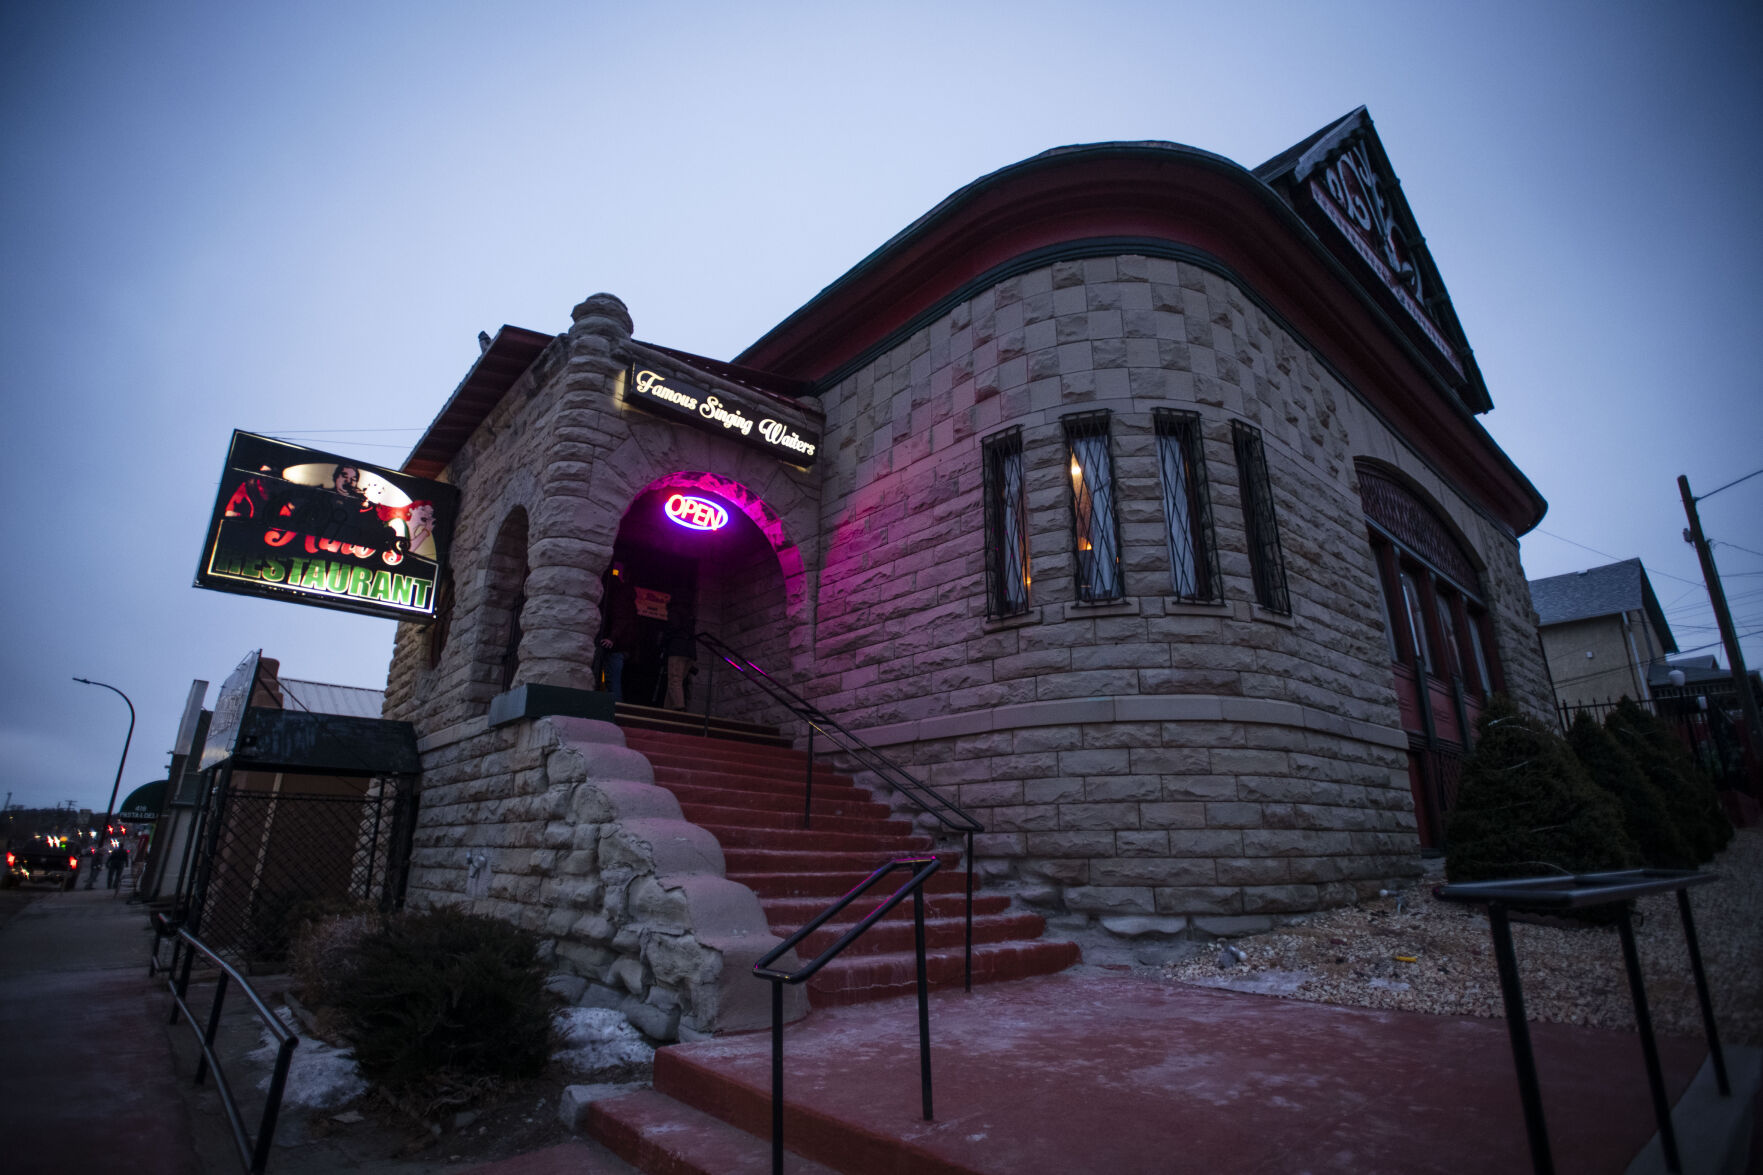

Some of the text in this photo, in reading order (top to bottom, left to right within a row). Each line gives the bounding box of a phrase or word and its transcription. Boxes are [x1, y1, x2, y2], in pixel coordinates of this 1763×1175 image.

[636, 370, 816, 456] Famous Singing Waiters
[667, 494, 722, 531] OPEN
